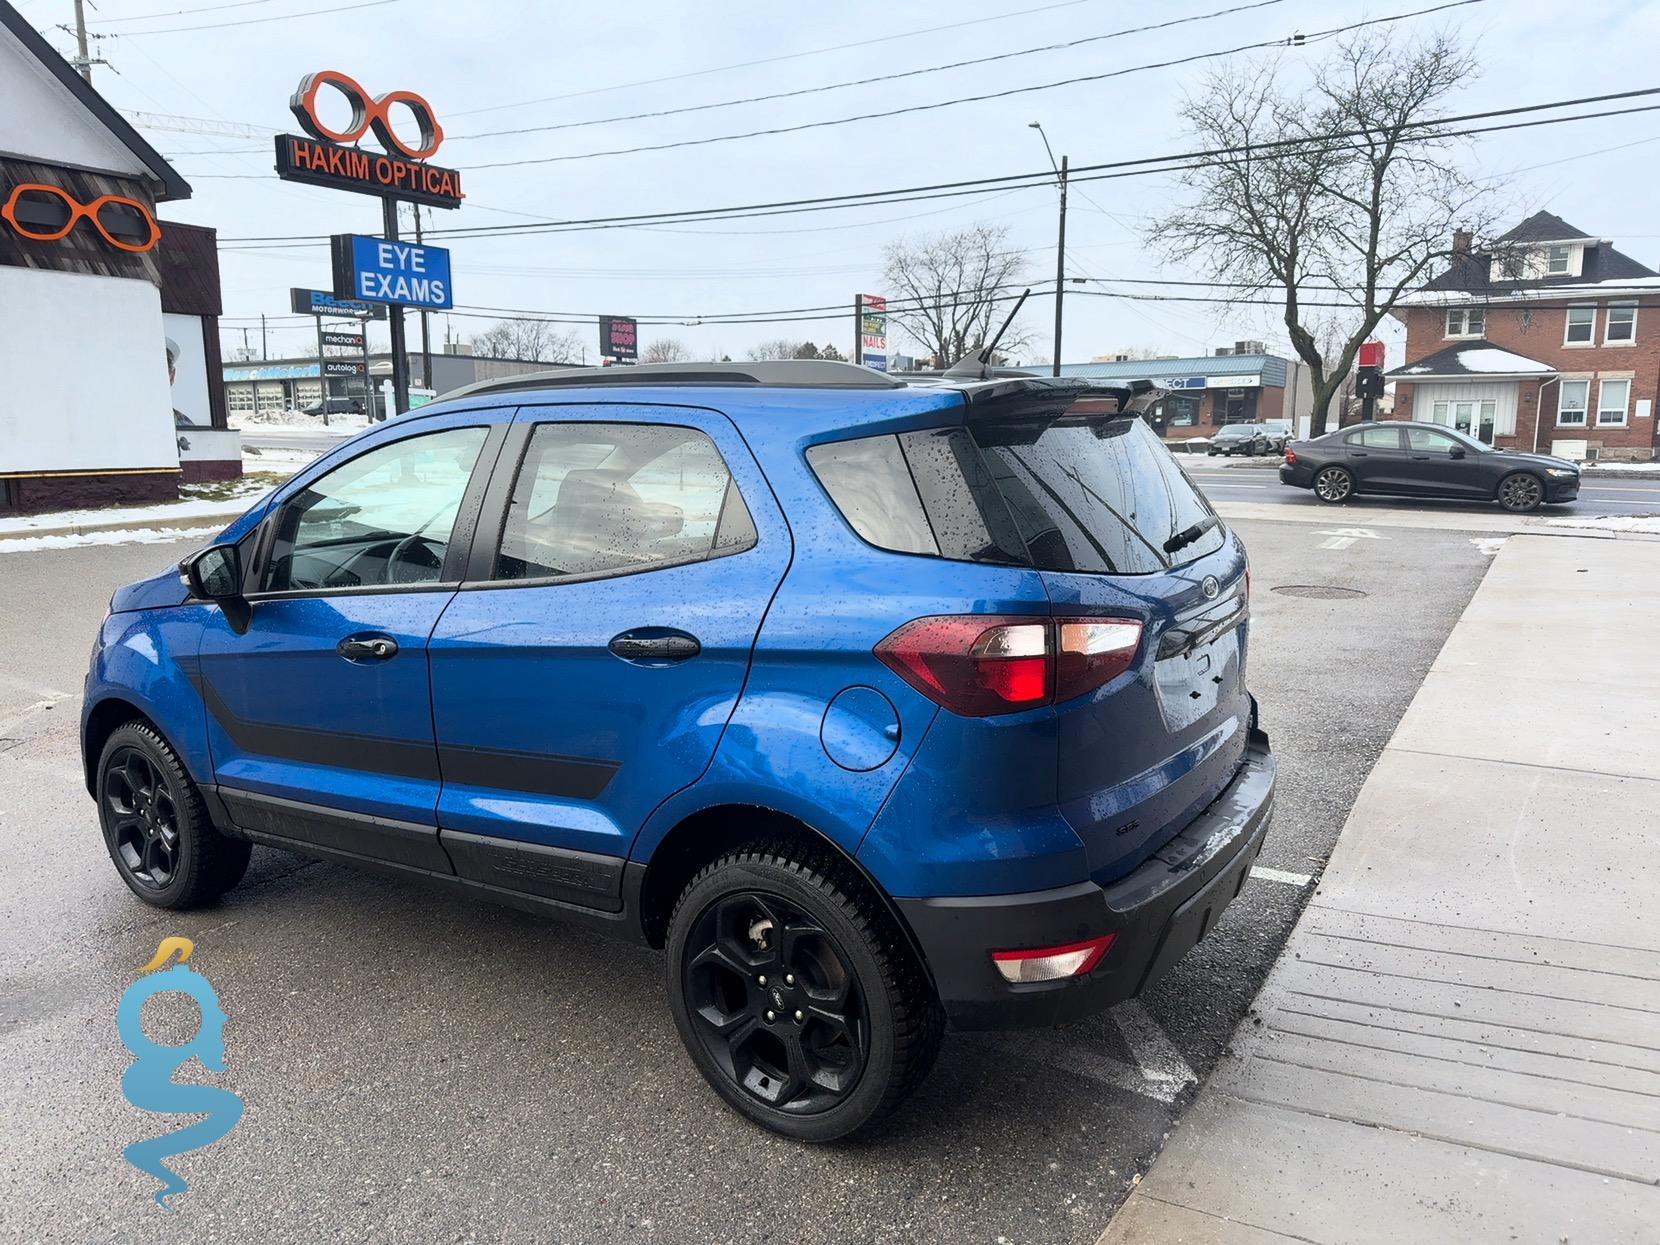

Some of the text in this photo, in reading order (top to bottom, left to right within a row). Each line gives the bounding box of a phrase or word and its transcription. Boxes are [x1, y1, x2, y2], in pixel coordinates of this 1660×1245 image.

[292, 139, 466, 199] HAKIM OPTICAL
[378, 243, 426, 273] EYE
[360, 271, 446, 304] EXAMS
[863, 336, 886, 350] NAILS
